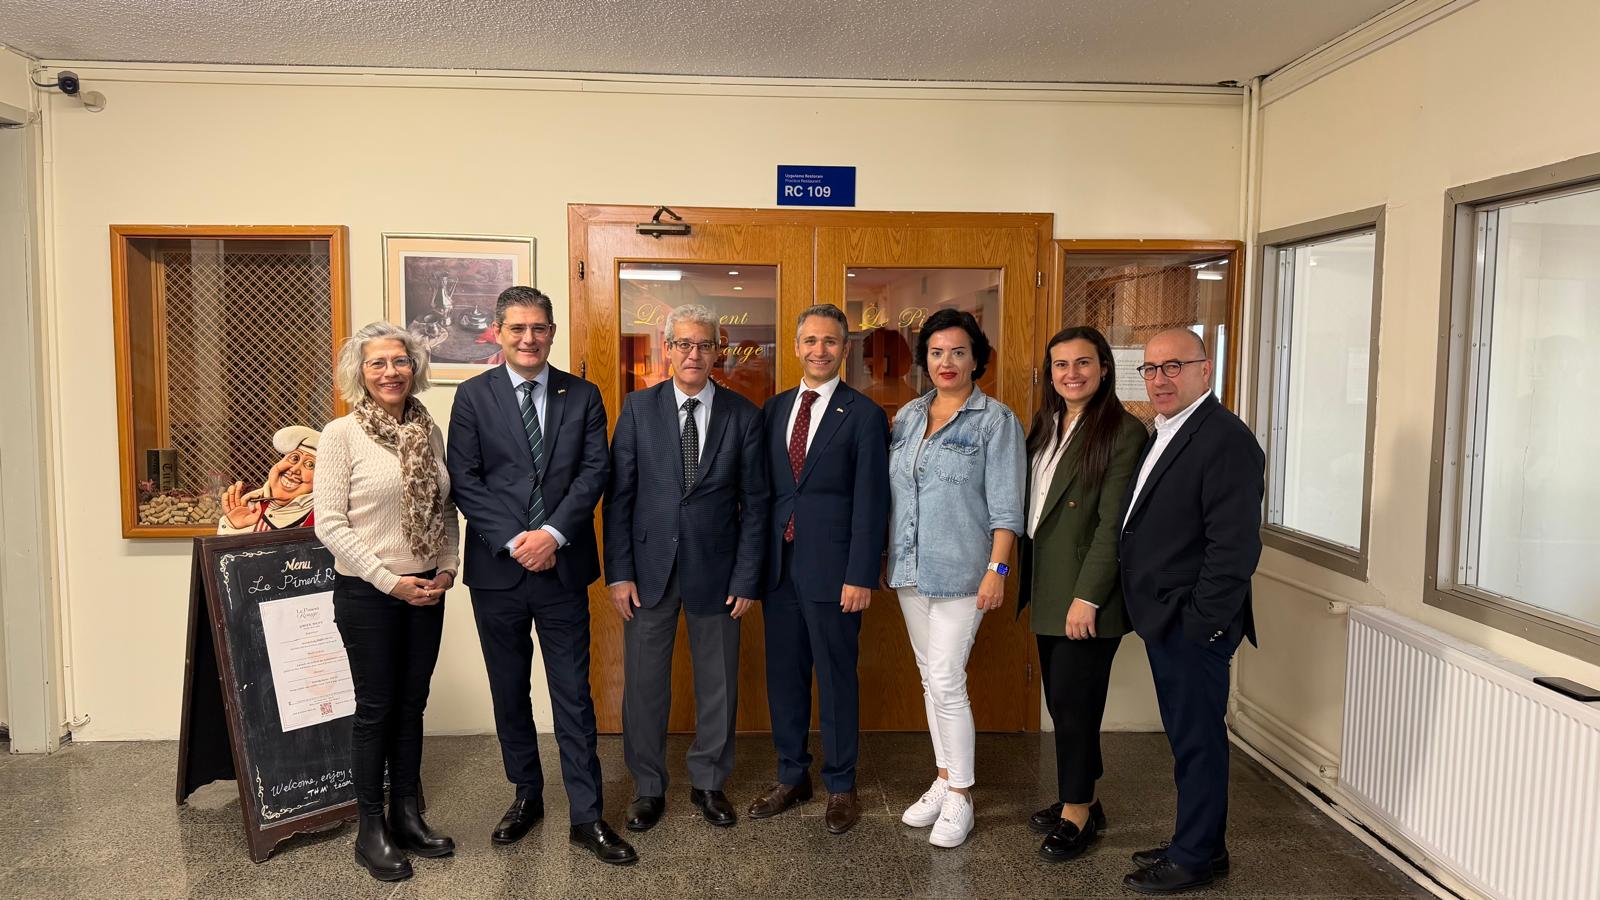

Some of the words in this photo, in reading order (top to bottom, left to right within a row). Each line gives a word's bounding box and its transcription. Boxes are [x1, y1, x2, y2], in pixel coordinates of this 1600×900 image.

[784, 185, 804, 197] RC
[807, 186, 831, 198] 109
[634, 303, 665, 326] Le
[281, 557, 312, 573] Menu
[248, 576, 272, 594] Le
[277, 569, 322, 590] Piment
[270, 778, 318, 797] Welcome,
[320, 769, 346, 784] enjoy
[333, 779, 354, 790] team
